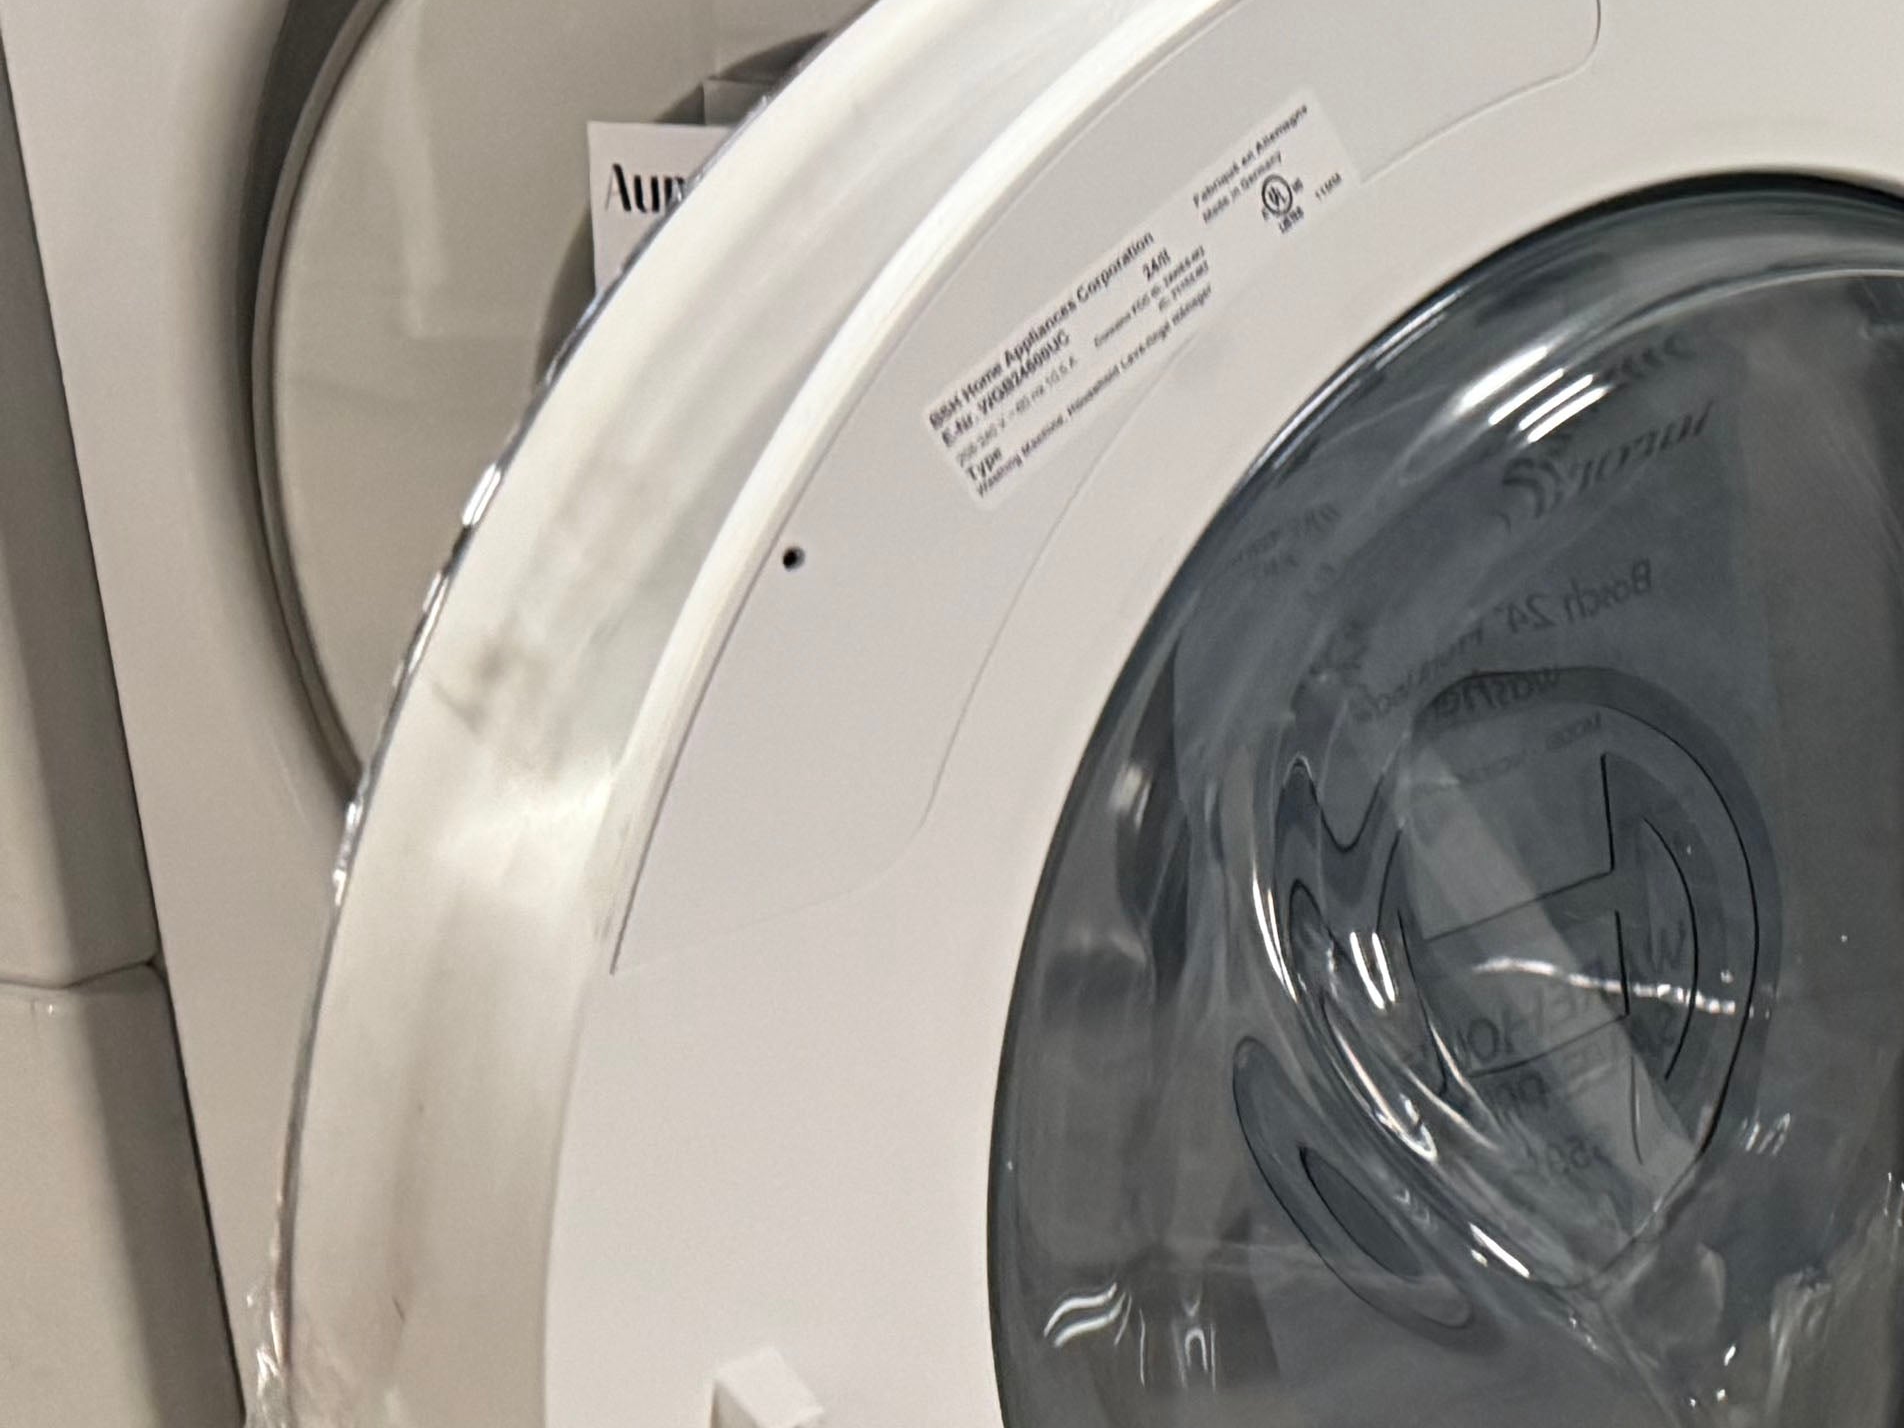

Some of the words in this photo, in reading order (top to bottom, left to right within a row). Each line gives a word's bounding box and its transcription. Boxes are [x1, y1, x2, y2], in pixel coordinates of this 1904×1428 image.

[1004, 299, 1077, 367] Appliances
[1076, 232, 1154, 303] Corporation
[967, 448, 1002, 481] Type
